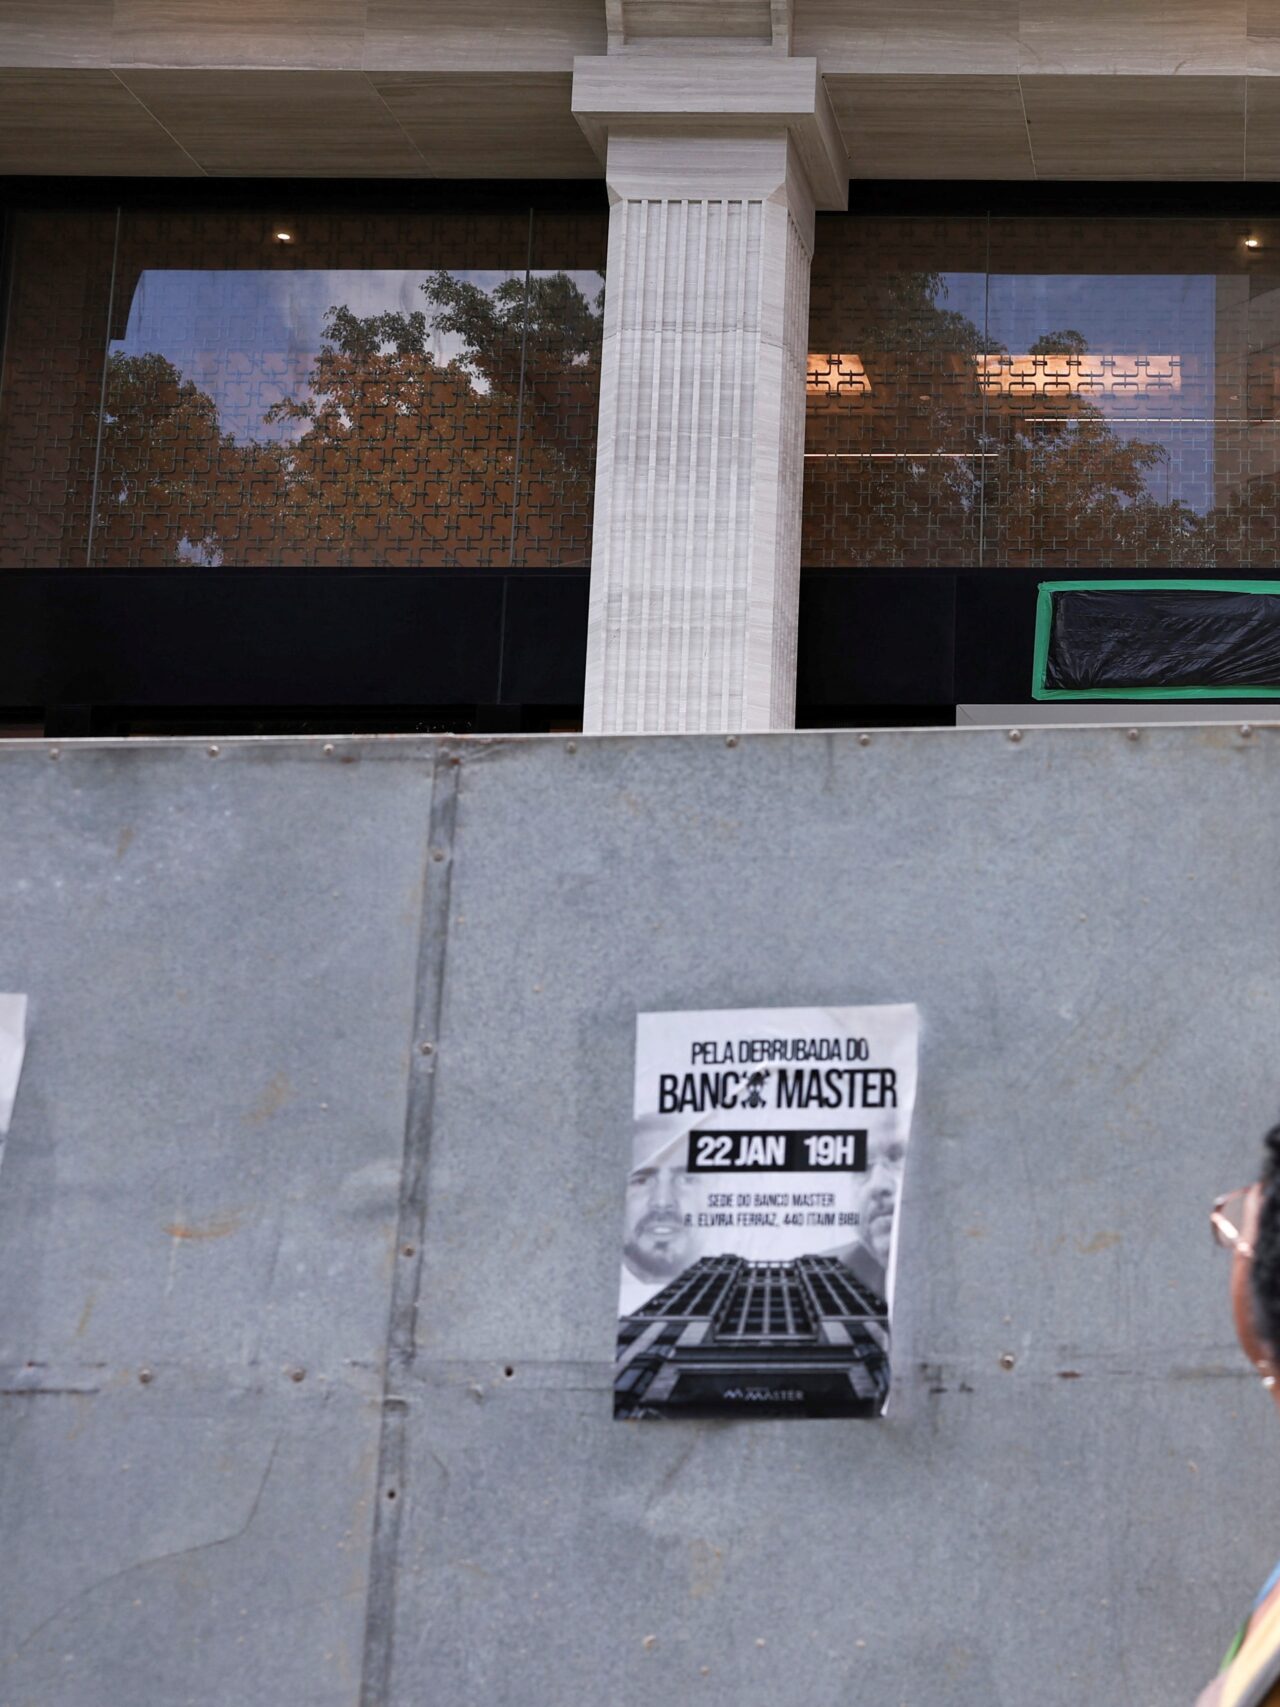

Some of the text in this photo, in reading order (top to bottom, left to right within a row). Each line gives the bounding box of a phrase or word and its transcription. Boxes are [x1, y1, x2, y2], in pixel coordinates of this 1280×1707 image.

[691, 1038, 869, 1065] PELA DERRUBADA DO
[776, 1068, 897, 1108] MASTER
[695, 1135, 854, 1166] 22 JAN 19H
[708, 1192, 835, 1207] SEDE DO BANCO MASTER
